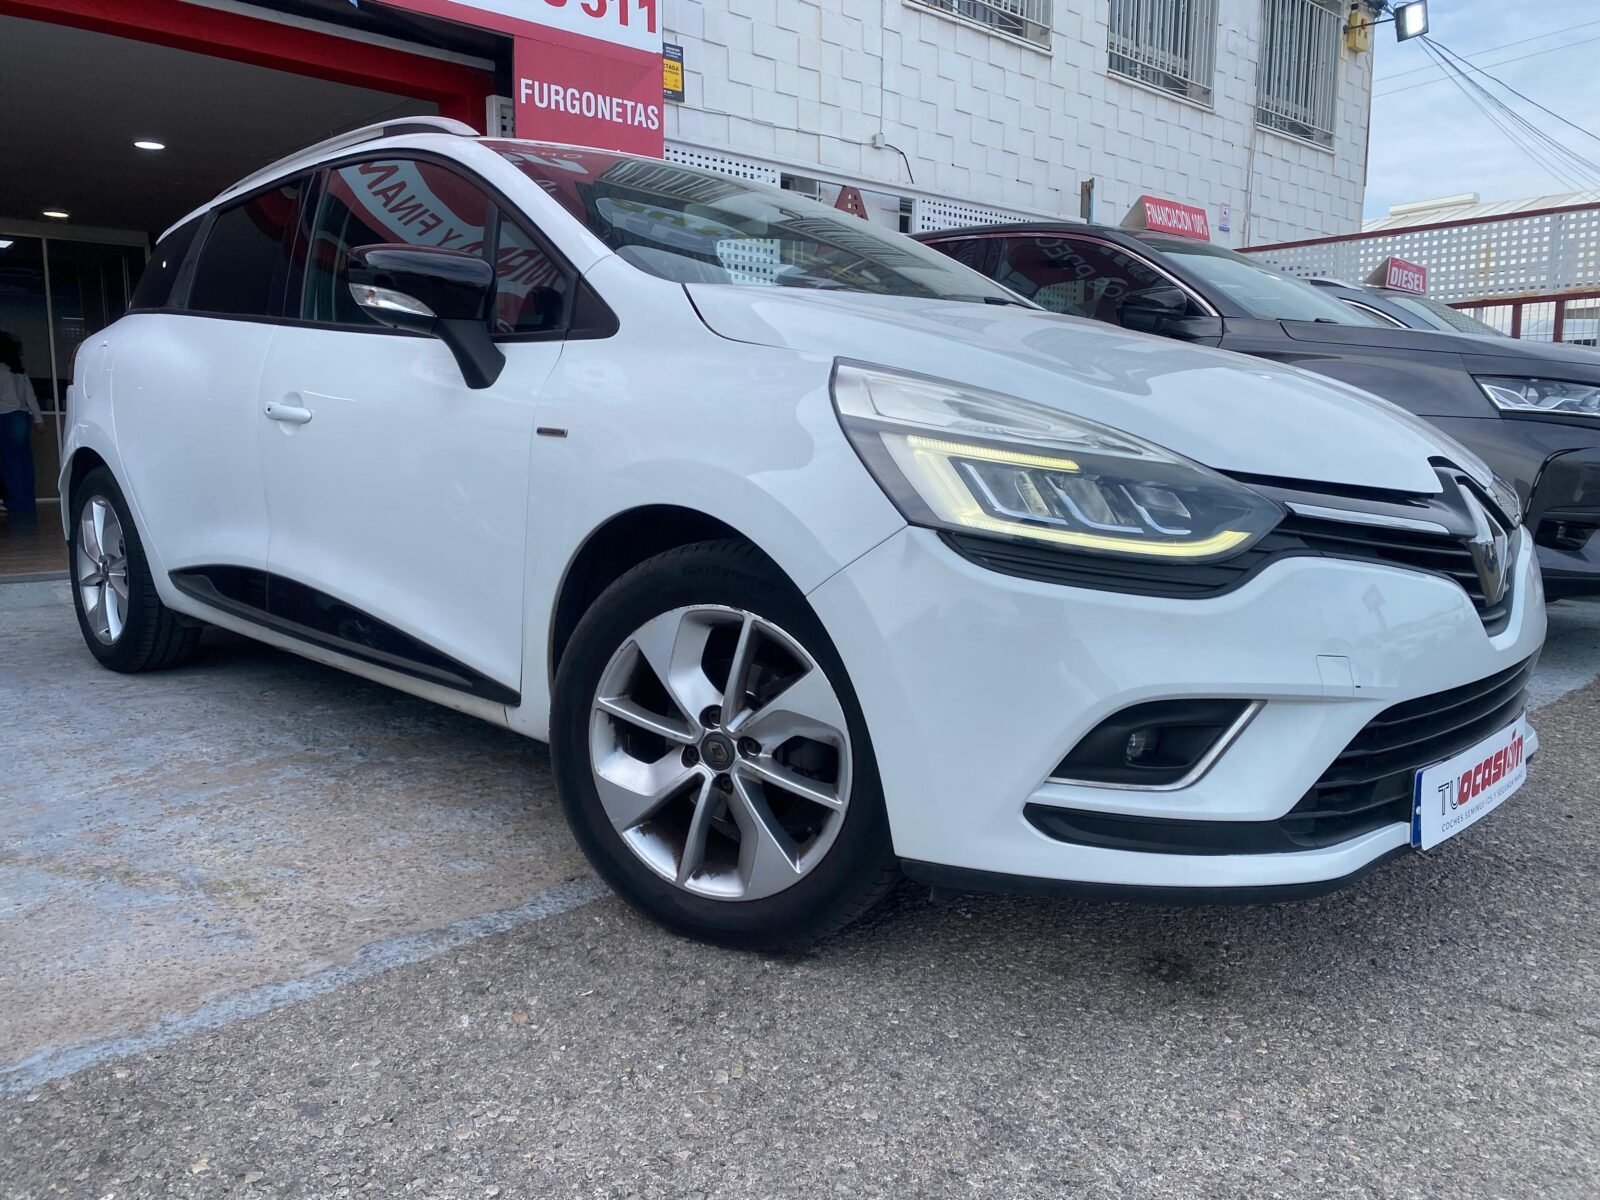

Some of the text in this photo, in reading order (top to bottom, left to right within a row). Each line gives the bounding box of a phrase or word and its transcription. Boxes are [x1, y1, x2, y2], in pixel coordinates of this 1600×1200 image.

[520, 77, 660, 130] FURGONETAS
[1145, 202, 1193, 232] FINANCIACIÓN
[1390, 266, 1425, 293] DIESEL
[1441, 814, 1464, 833] COCHES
